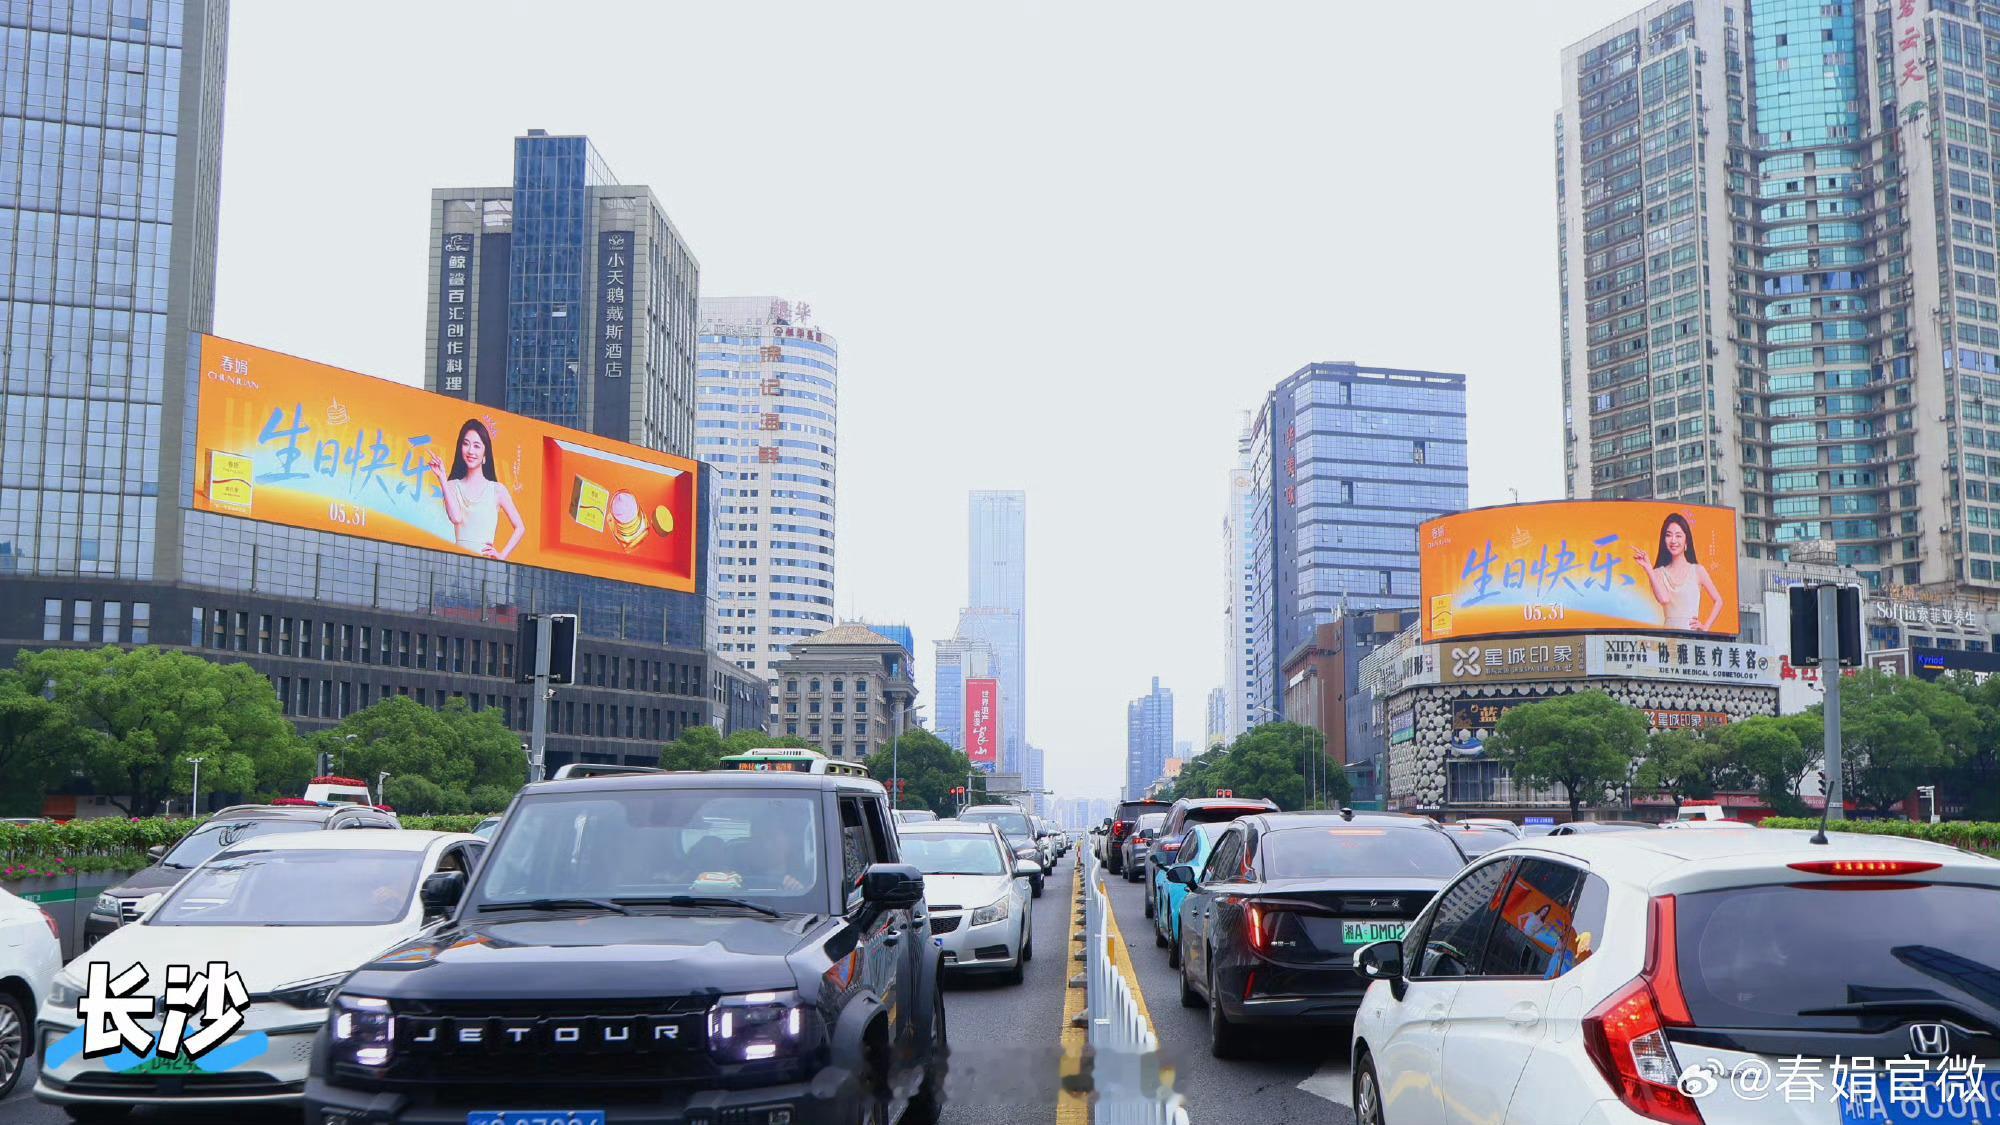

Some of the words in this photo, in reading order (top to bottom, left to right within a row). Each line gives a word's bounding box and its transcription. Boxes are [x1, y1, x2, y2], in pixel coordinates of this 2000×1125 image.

[605, 253, 624, 378] 小天鹅戴斯酒店
[221, 356, 248, 375] 春娟
[256, 403, 444, 504] 生日快乐
[329, 503, 368, 527] 05.31
[1461, 534, 1636, 607] 生日快乐
[1524, 603, 1565, 621] 05.31
[1485, 645, 1573, 666] 星城印象
[1605, 640, 1648, 652] XIEYA
[1657, 642, 1757, 669] 协雅医疗美容
[1658, 712, 1701, 727] 星城印象
[413, 1025, 679, 1042] JETOUR
